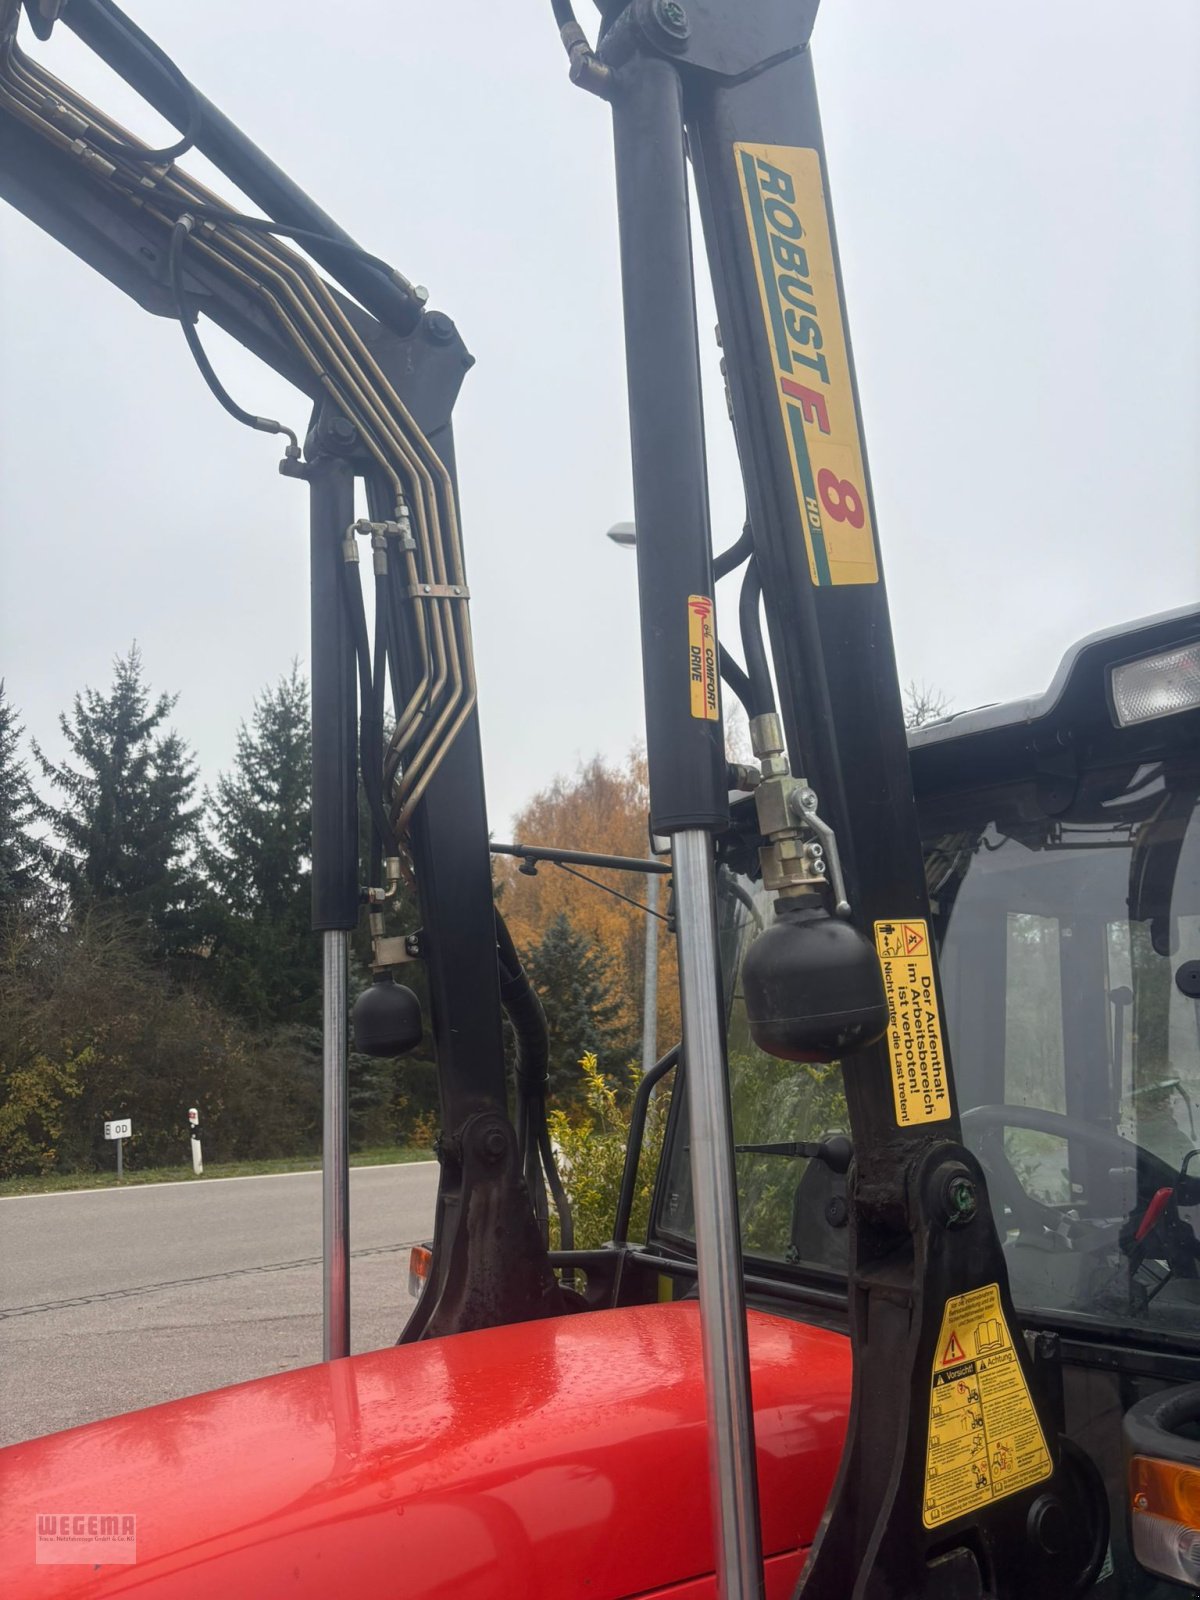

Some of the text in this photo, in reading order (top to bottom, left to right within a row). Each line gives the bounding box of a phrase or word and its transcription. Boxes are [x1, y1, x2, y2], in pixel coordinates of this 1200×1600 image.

[756, 159, 865, 530] ROBUST F 8
[805, 496, 821, 528] HD
[691, 645, 702, 683] DRIVE
[705, 648, 716, 710] COMFORT-
[884, 961, 910, 1122] Nicht unter die Last treten!
[898, 986, 920, 1094] ist verboten!
[907, 963, 935, 1115] im Arbeitsbereich
[921, 976, 945, 1100] Der Aufenthalt
[115, 1124, 128, 1134] OD
[946, 1364, 974, 1379] Vorsicht!
[987, 1353, 1012, 1367] Achtung
